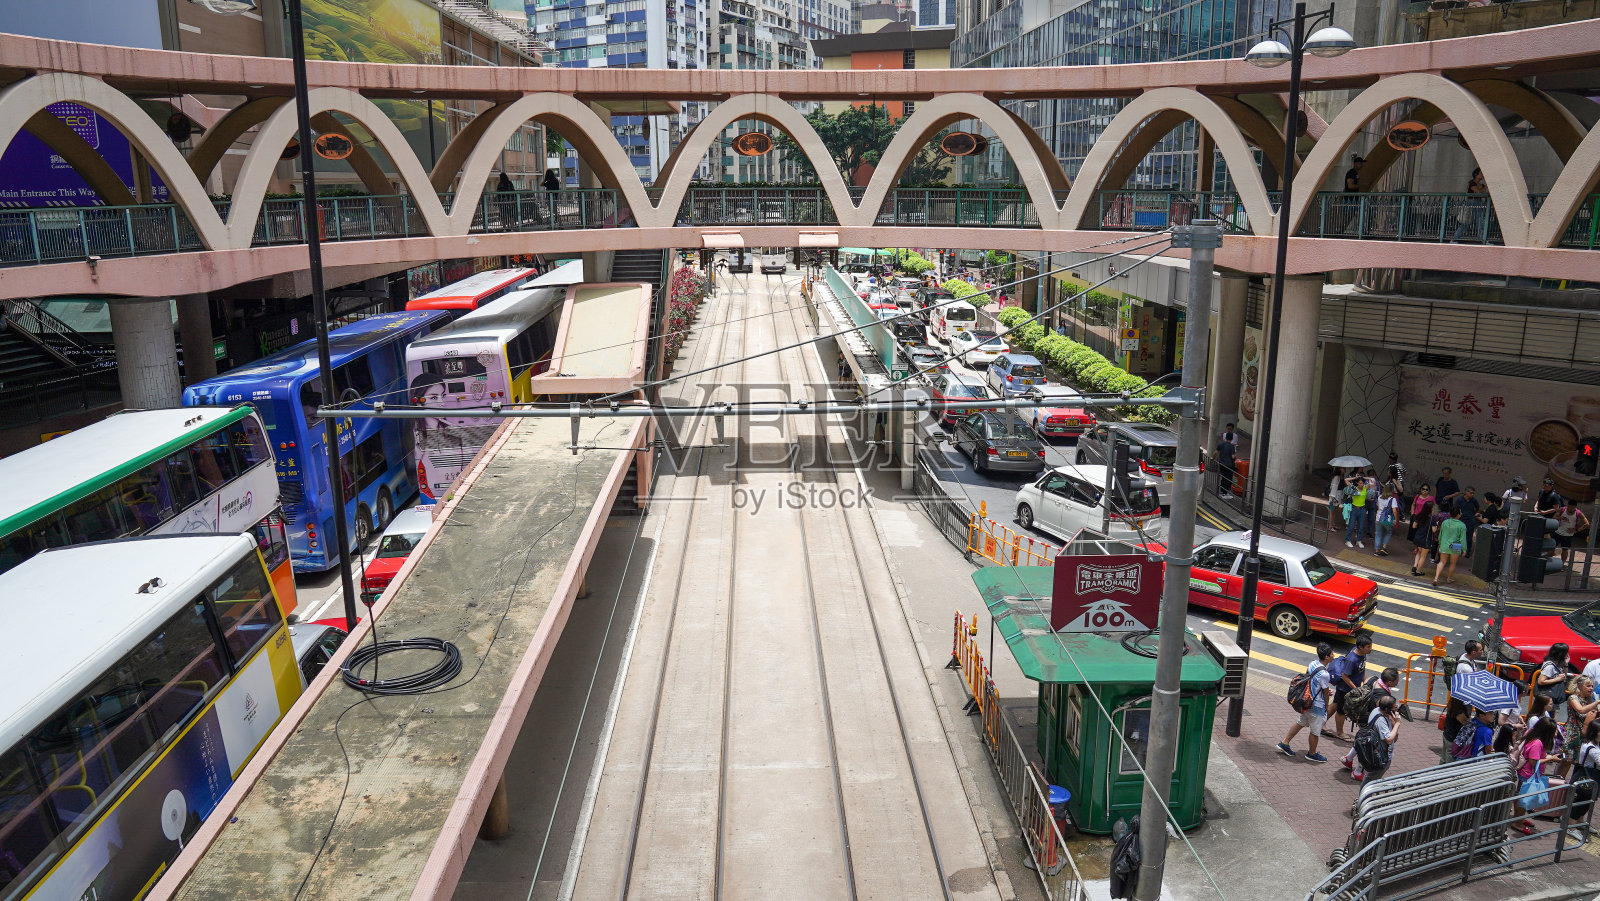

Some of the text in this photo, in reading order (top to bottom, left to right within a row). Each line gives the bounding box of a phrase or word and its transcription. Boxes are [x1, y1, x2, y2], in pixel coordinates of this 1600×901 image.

[21, 188, 57, 198] Entrance
[58, 188, 77, 197] This
[78, 187, 96, 198] Way
[1432, 388, 1506, 419] 鼎泰豐
[1080, 579, 1137, 590] TRAMORAMIC
